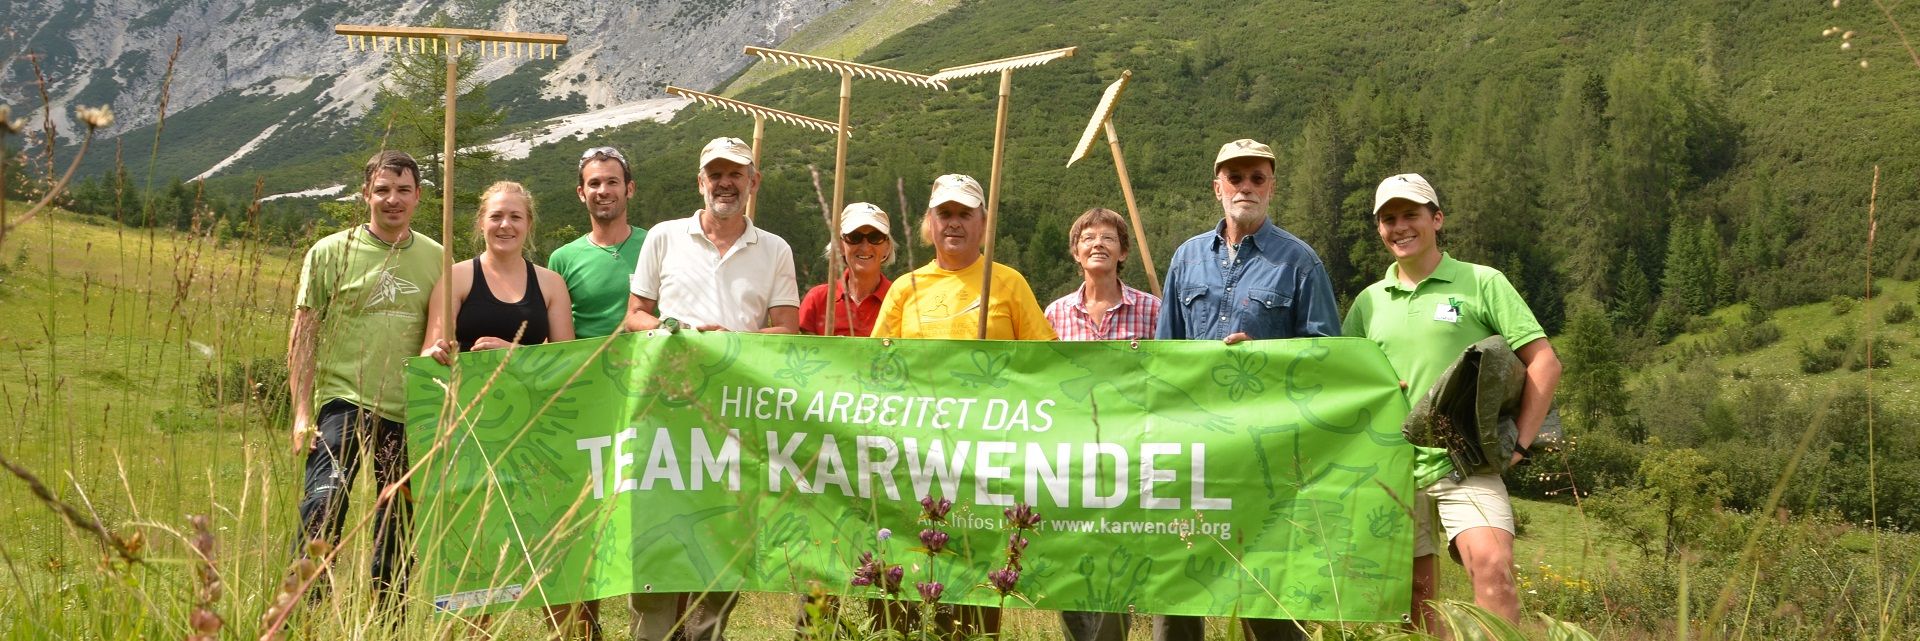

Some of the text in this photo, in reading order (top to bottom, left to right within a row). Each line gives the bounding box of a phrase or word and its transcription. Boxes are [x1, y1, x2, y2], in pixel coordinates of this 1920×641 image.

[720, 385, 1056, 433] HIER ARBEITET DAS
[576, 427, 1233, 511] TEAM KARWENDEL
[952, 512, 995, 531] Infos
[1051, 518, 1231, 540] www.karwendel.org
